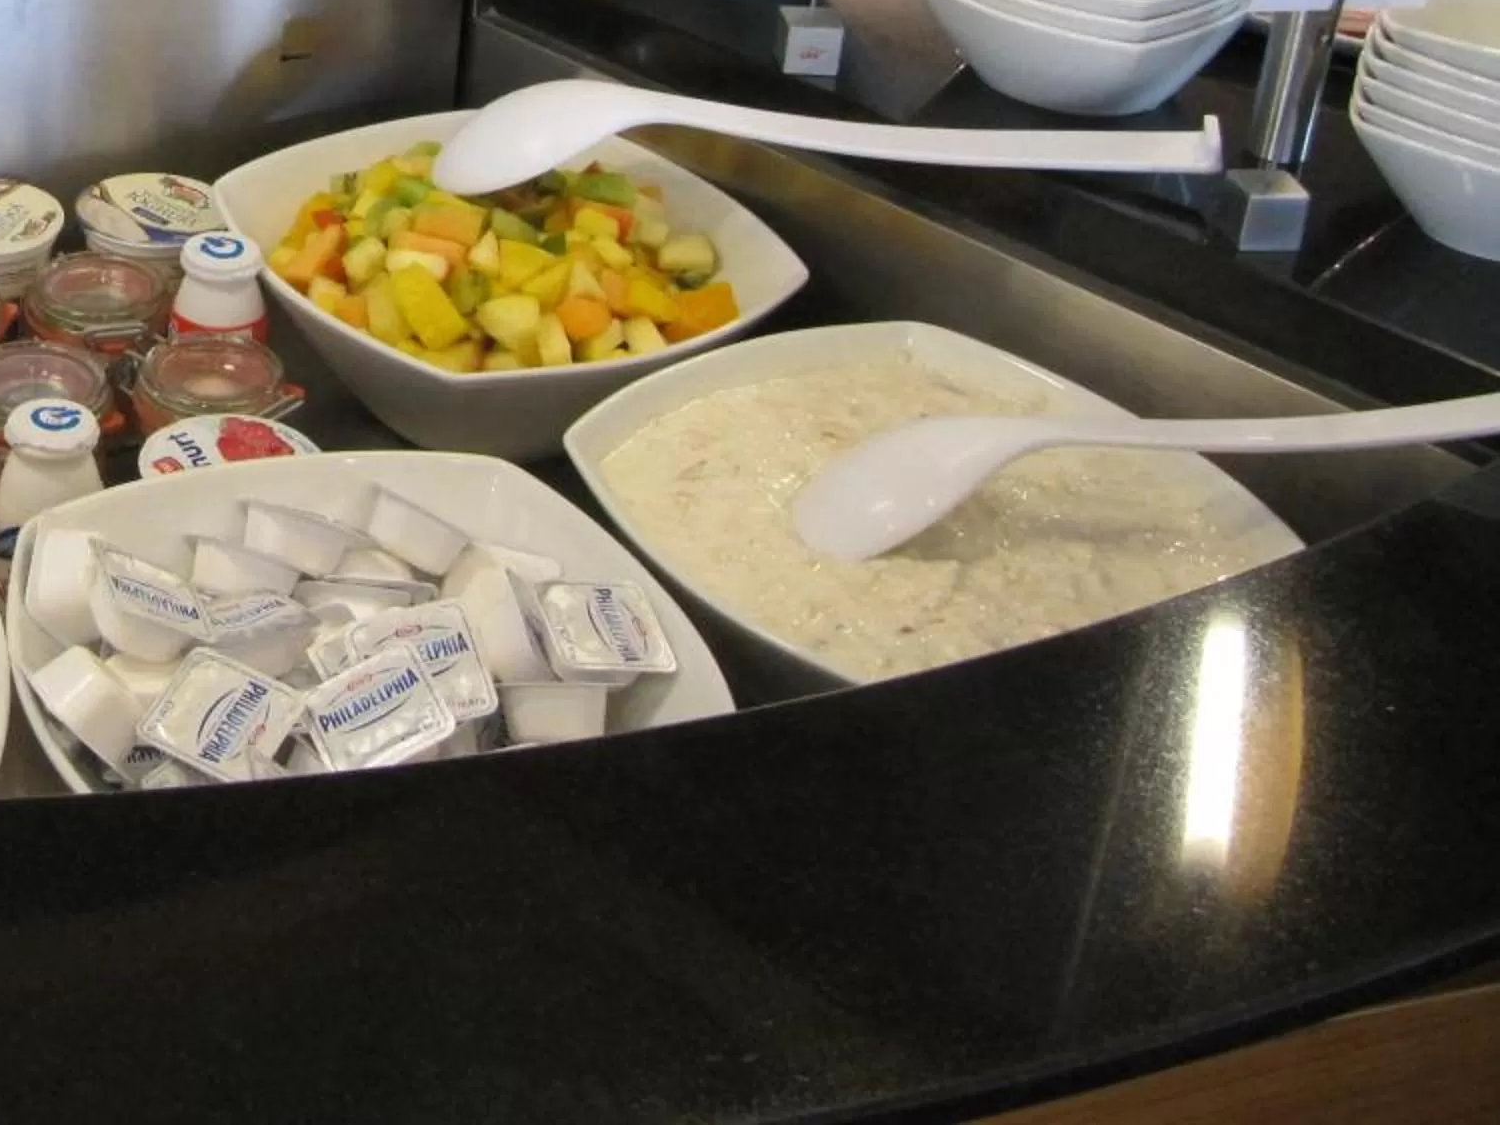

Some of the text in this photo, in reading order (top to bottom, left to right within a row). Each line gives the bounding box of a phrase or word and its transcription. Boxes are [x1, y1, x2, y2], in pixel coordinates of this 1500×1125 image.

[417, 631, 470, 663] ELPHIA
[198, 679, 269, 764] PHILADELPHIA
[318, 666, 419, 733] PHILADELPHIA
